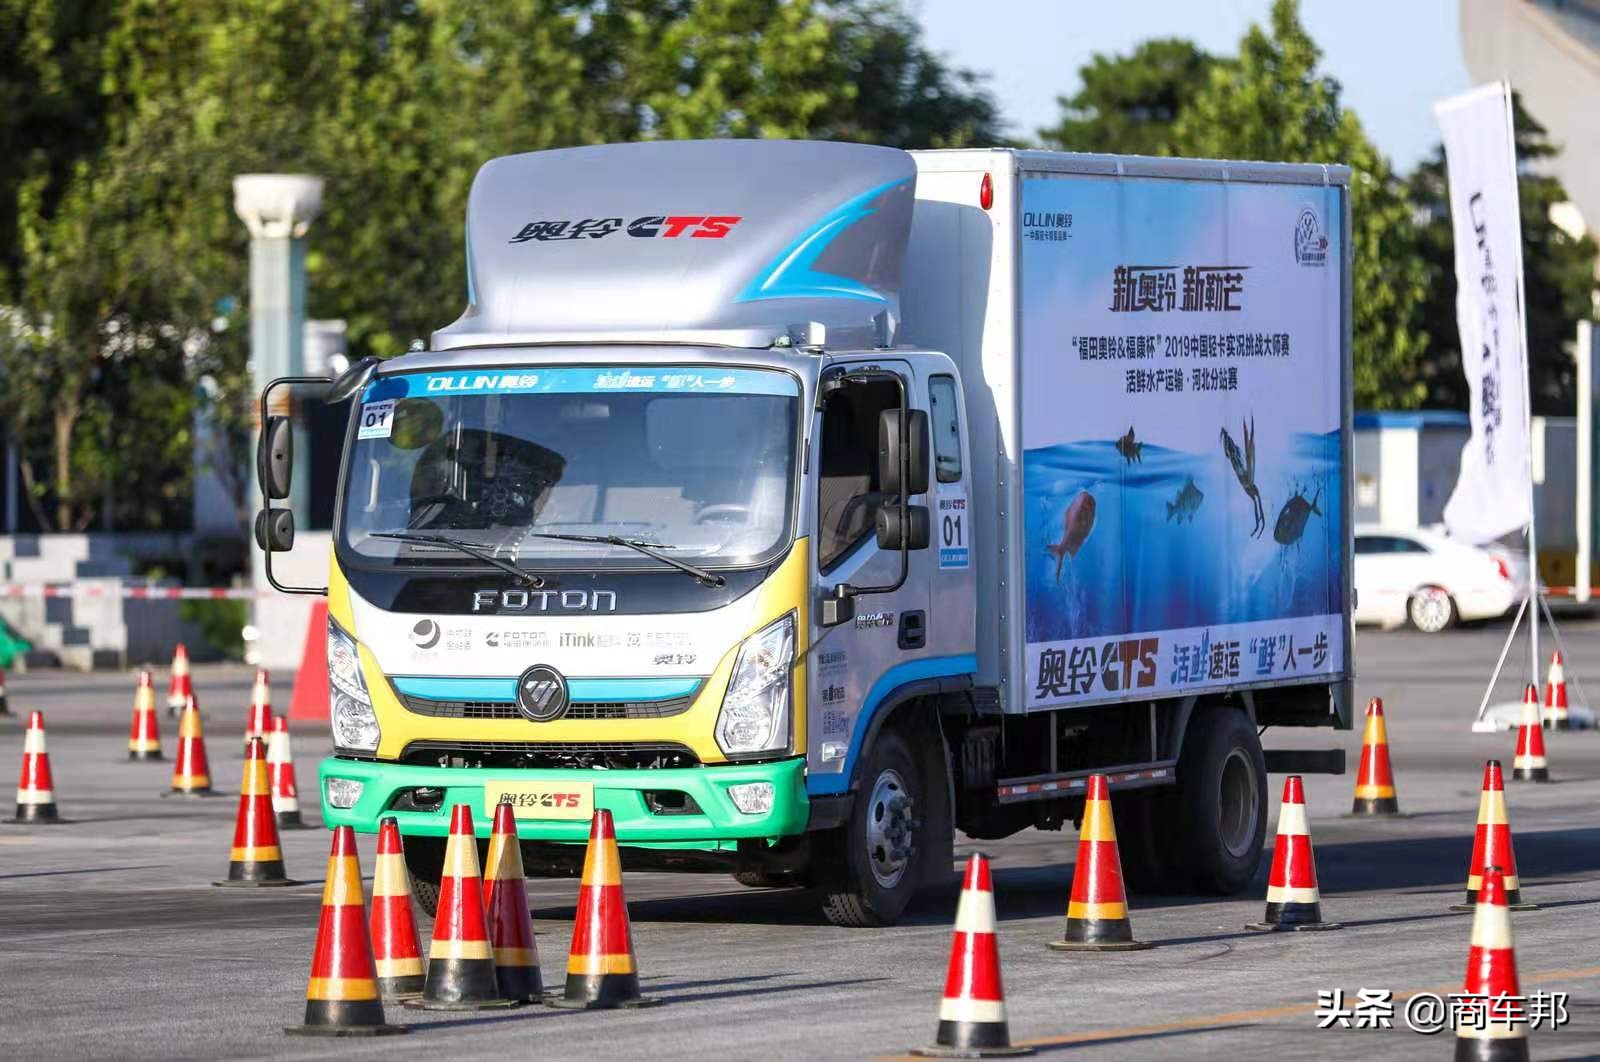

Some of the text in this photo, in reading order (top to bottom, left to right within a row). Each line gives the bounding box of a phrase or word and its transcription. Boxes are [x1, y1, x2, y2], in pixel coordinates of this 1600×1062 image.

[1108, 265, 1180, 312] 新奥铃
[366, 412, 387, 428] 01
[943, 515, 961, 547] 01
[473, 590, 617, 611] FOTON
[559, 632, 596, 648] iTink
[1170, 628, 1241, 685] 活鲜速运
